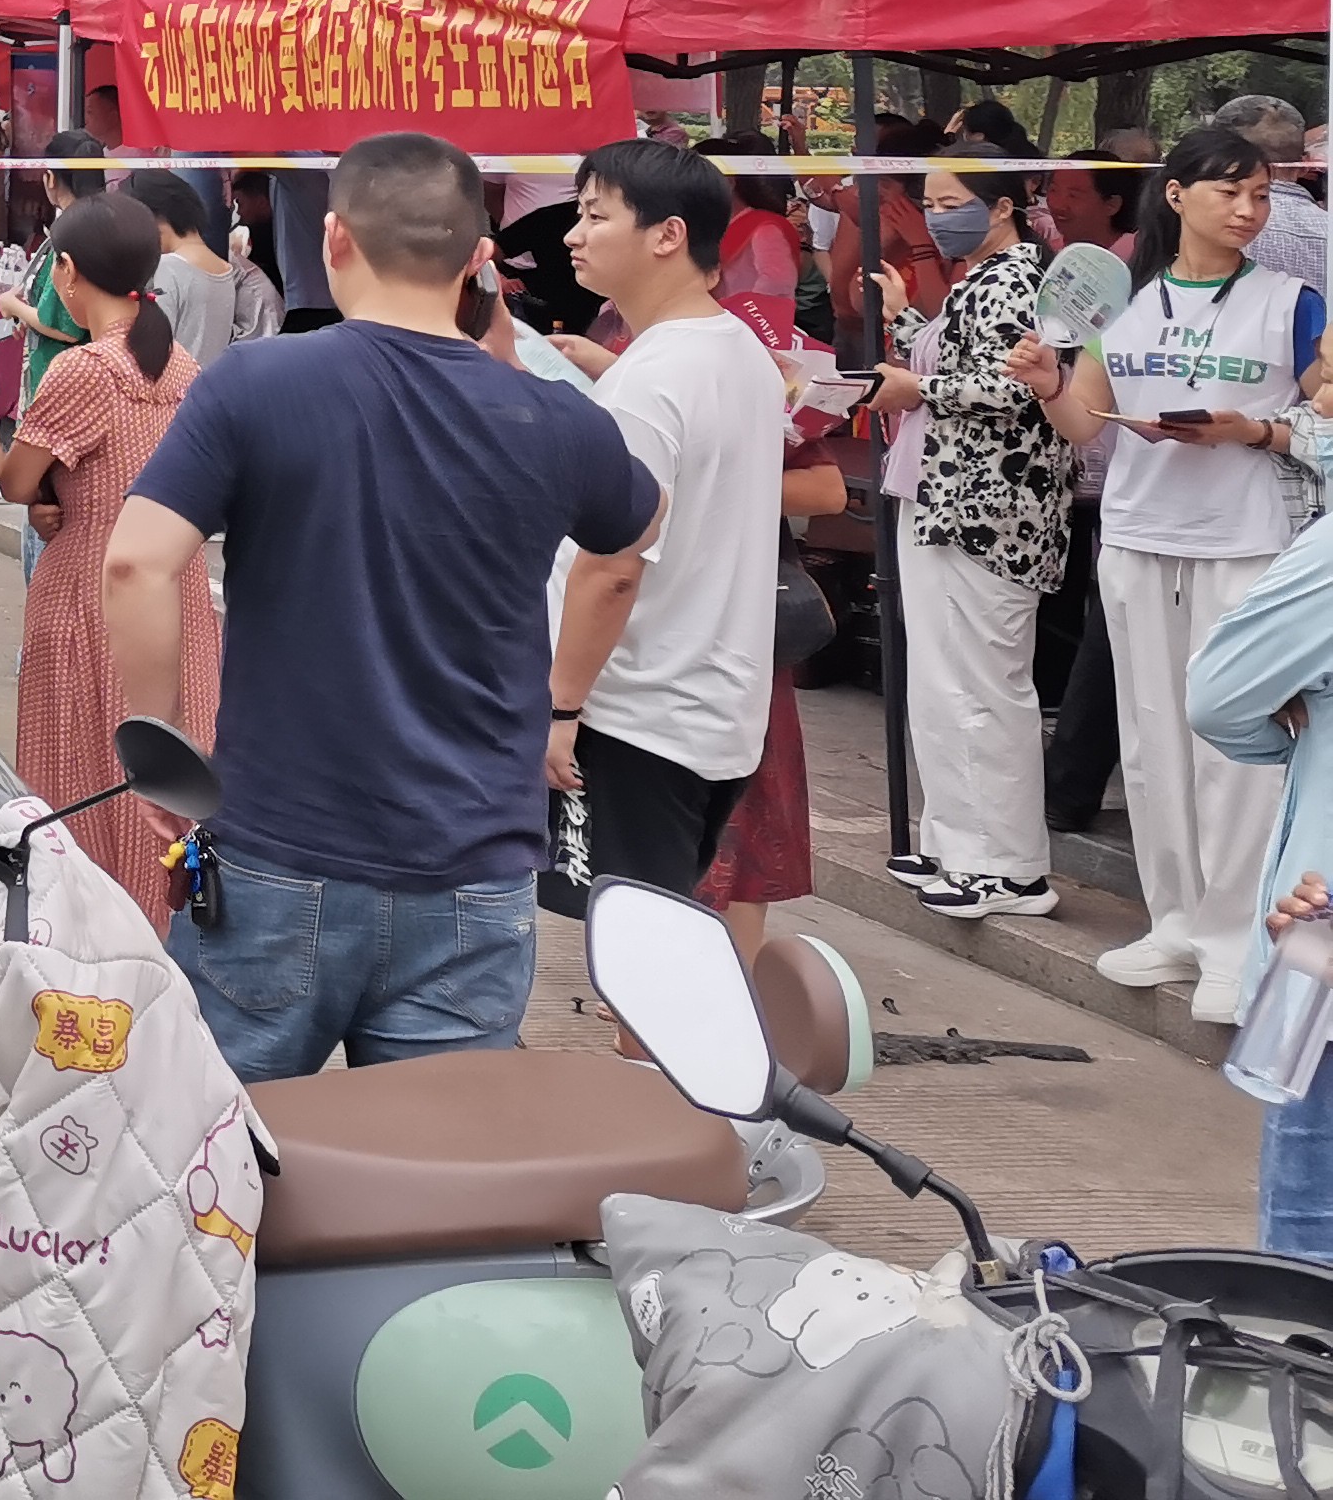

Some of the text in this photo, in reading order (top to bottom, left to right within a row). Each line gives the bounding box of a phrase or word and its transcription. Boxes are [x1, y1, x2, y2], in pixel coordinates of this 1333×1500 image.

[742, 299, 781, 348] FLOWER
[1158, 326, 1213, 348] I'M
[1106, 352, 1269, 385] BLESSED
[52, 1009, 118, 1055] 暴富
